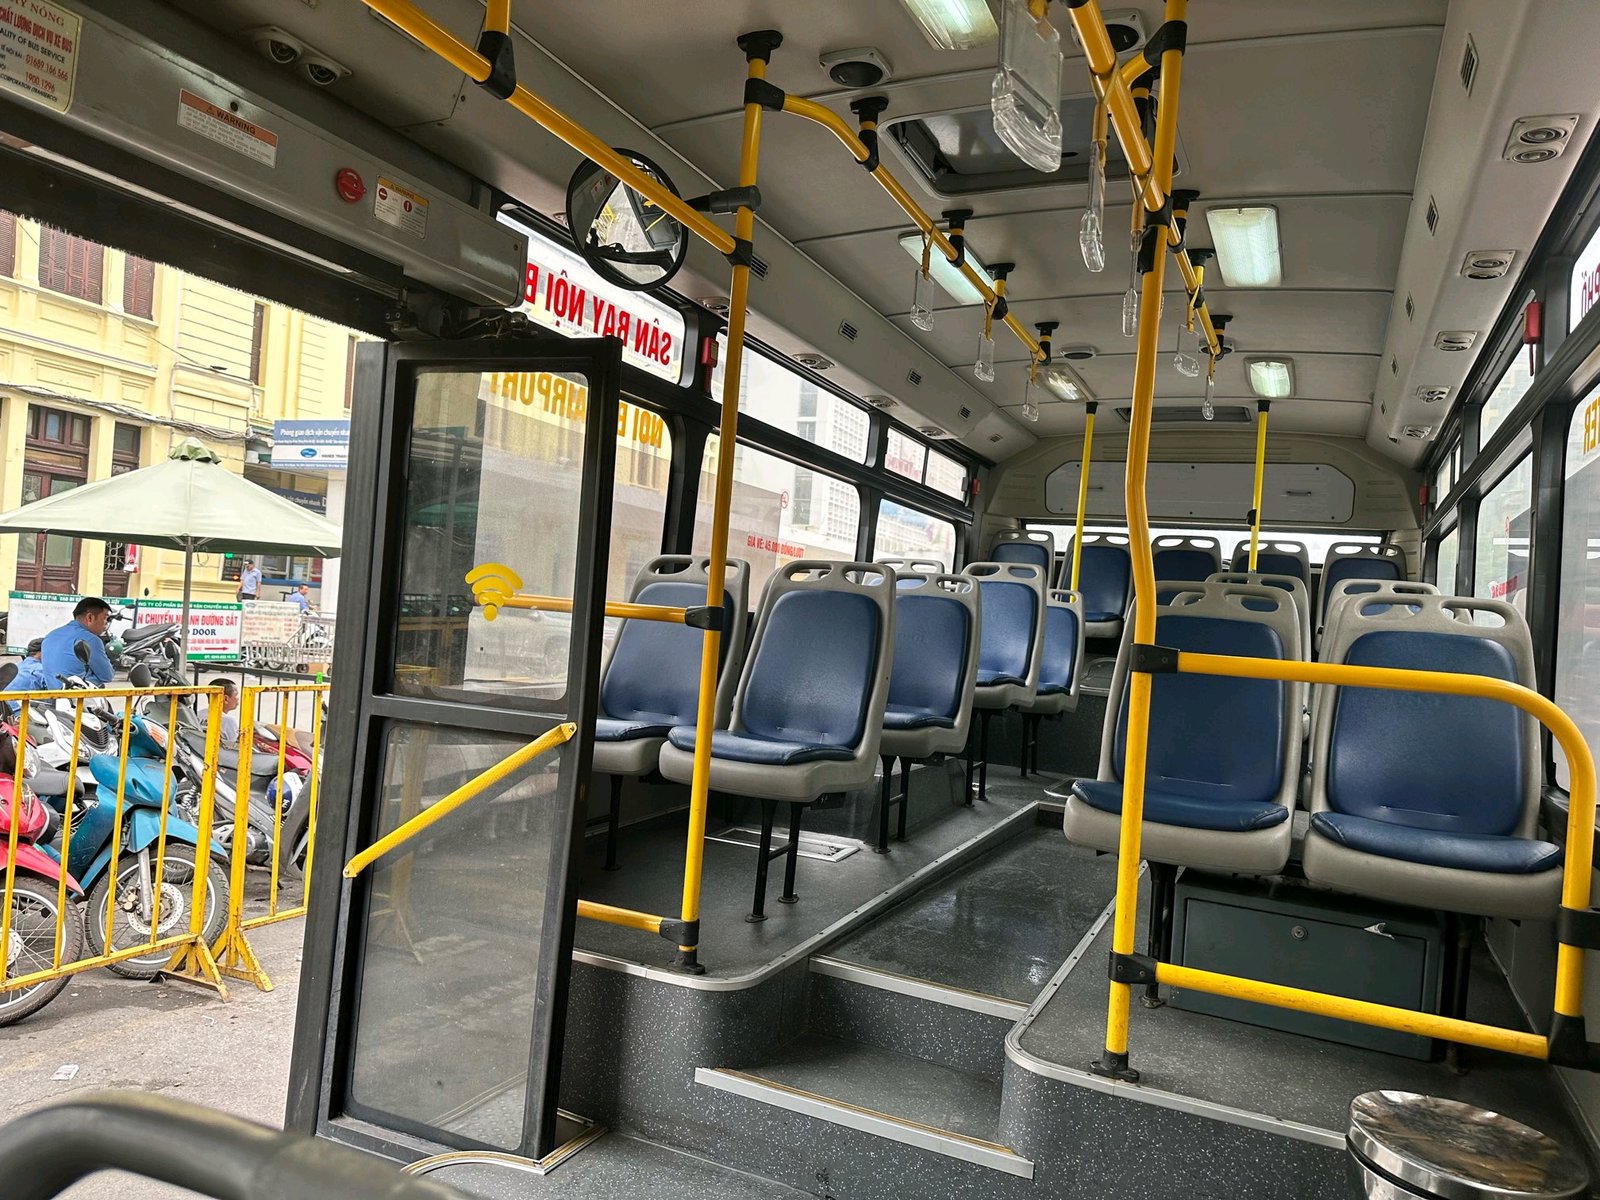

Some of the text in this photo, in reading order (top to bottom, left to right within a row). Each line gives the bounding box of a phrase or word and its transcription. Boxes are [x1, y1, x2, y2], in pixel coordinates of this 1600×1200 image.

[30, 3, 65, 27] NÓNG
[28, 41, 40, 52] BUS
[41, 46, 65, 64] SERVICE
[216, 110, 256, 135] WARNING
[145, 610, 173, 624] CHUYỂN
[226, 612, 238, 626] SẮT
